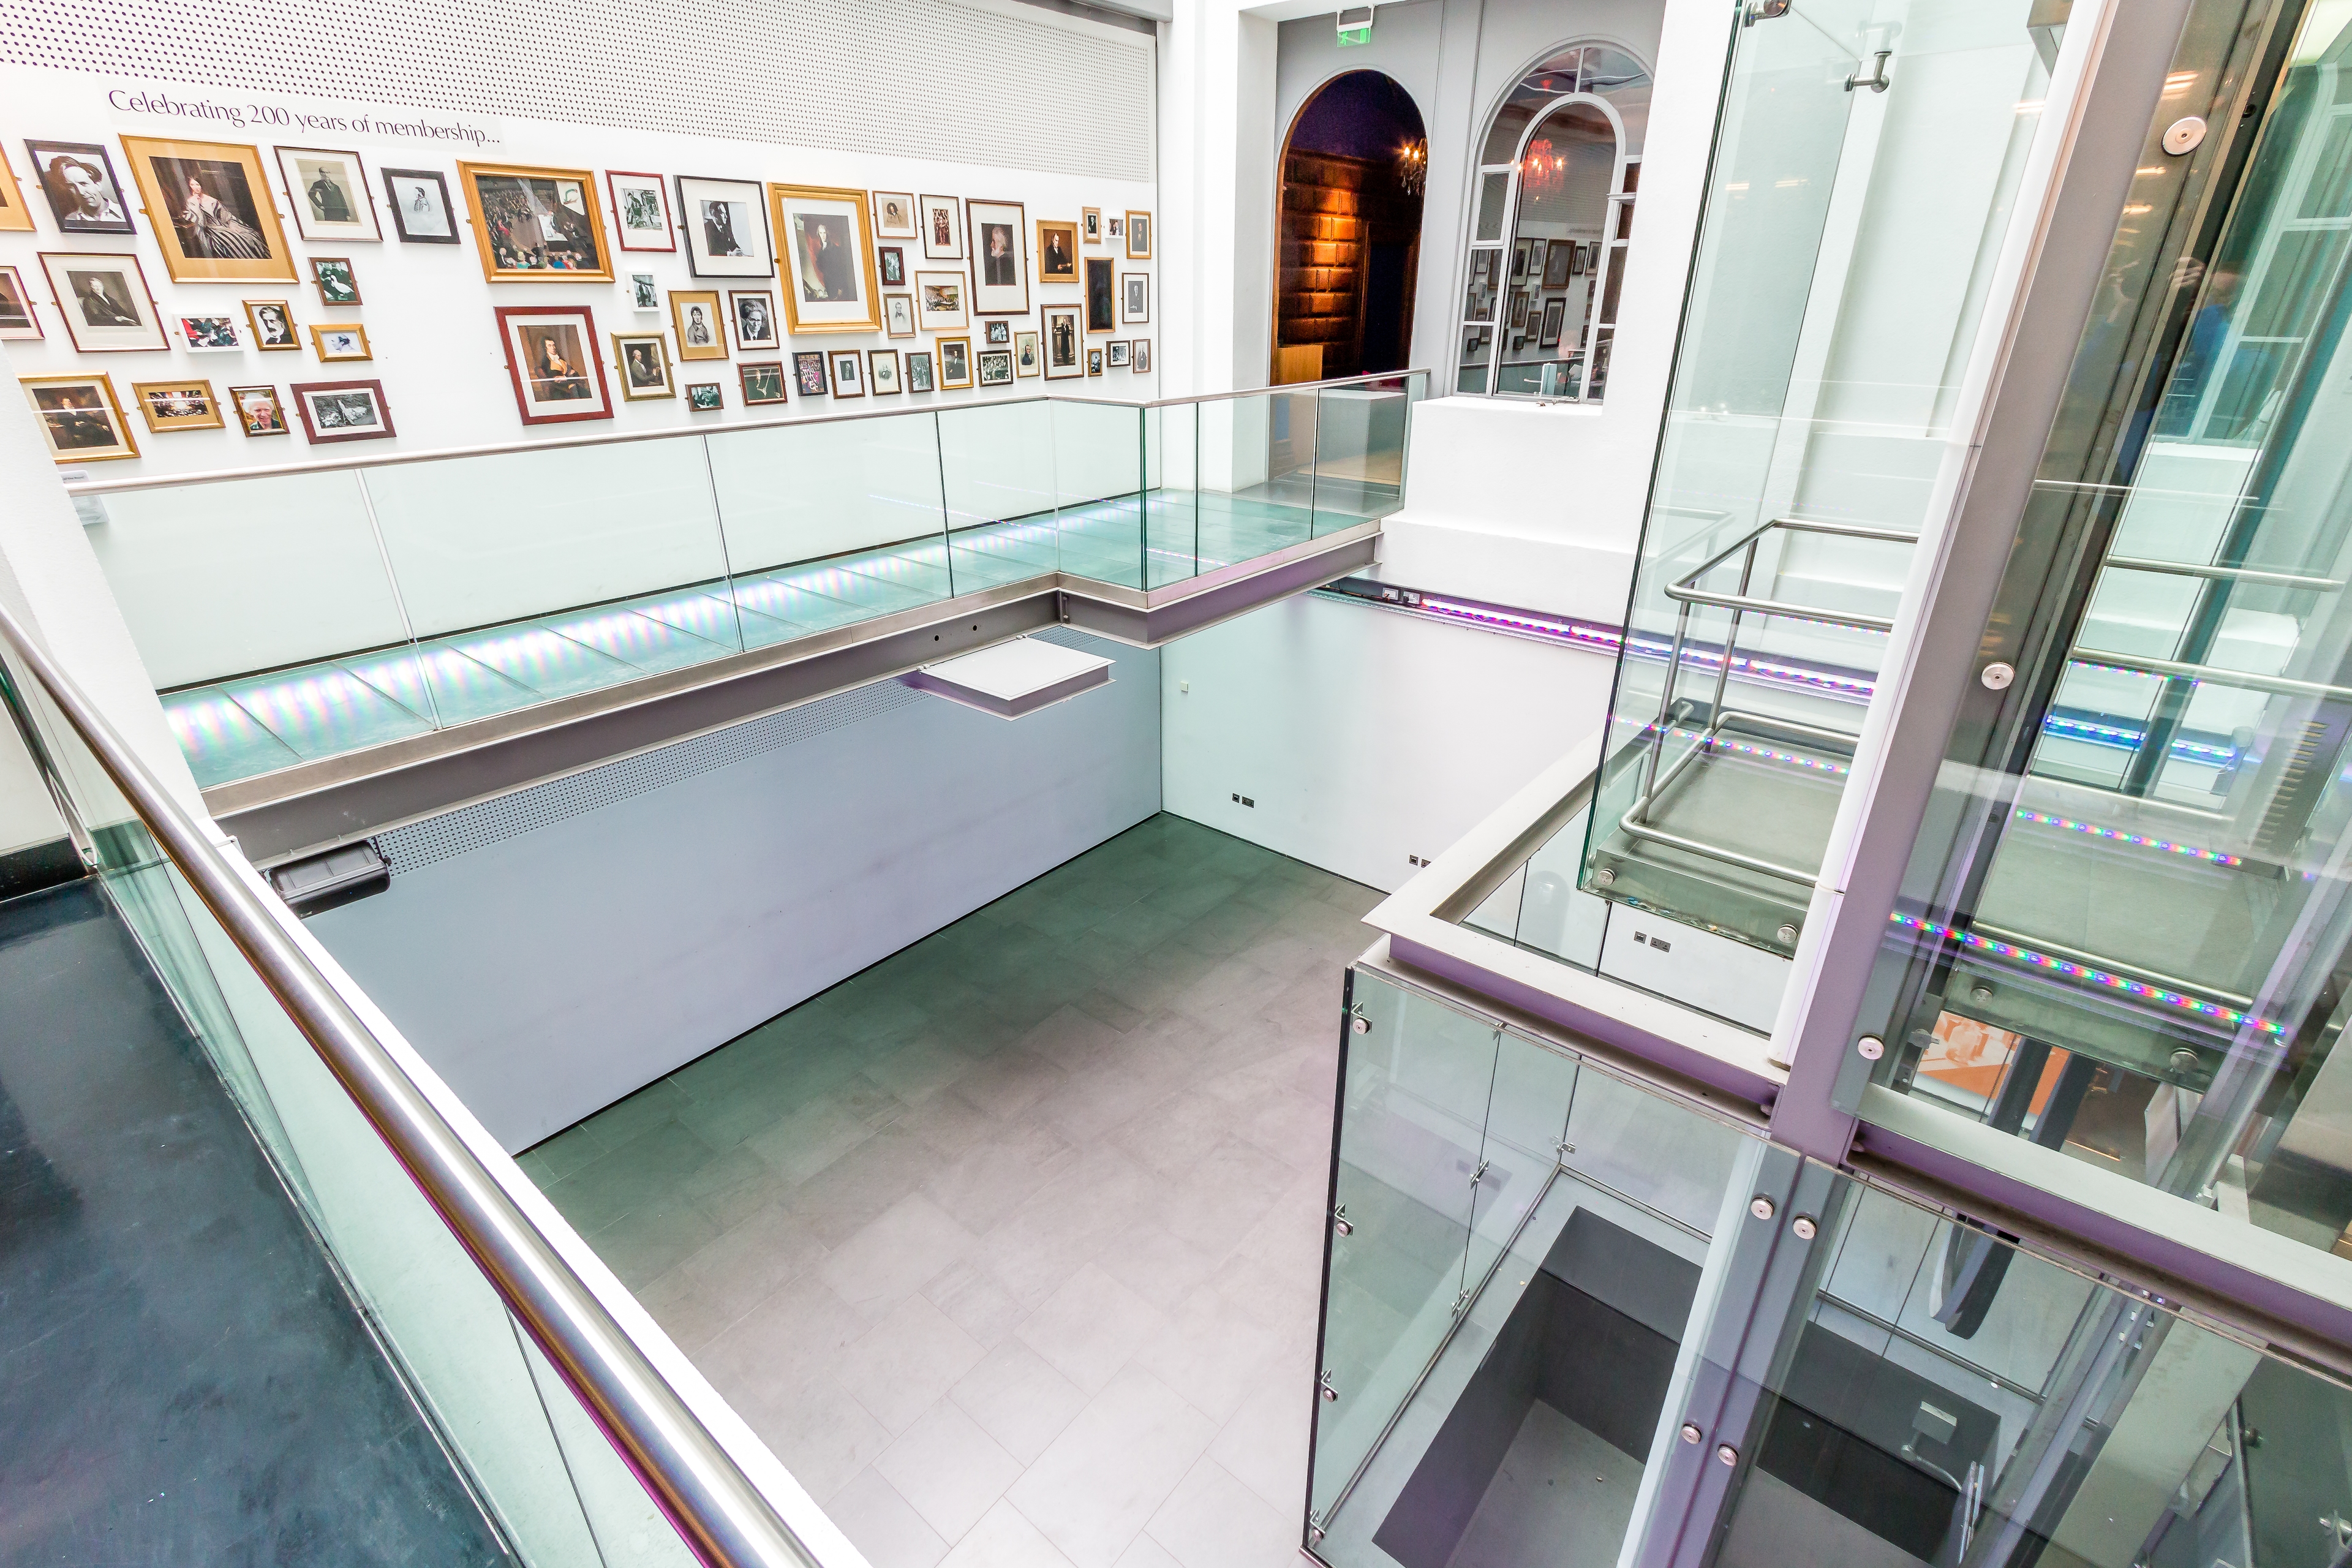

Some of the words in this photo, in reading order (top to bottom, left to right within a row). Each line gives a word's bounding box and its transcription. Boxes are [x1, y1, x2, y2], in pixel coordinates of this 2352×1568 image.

[108, 89, 246, 128] Celebrating
[249, 104, 290, 126] 200
[294, 113, 347, 134] years
[352, 114, 370, 133] of
[375, 119, 500, 148] membership...
